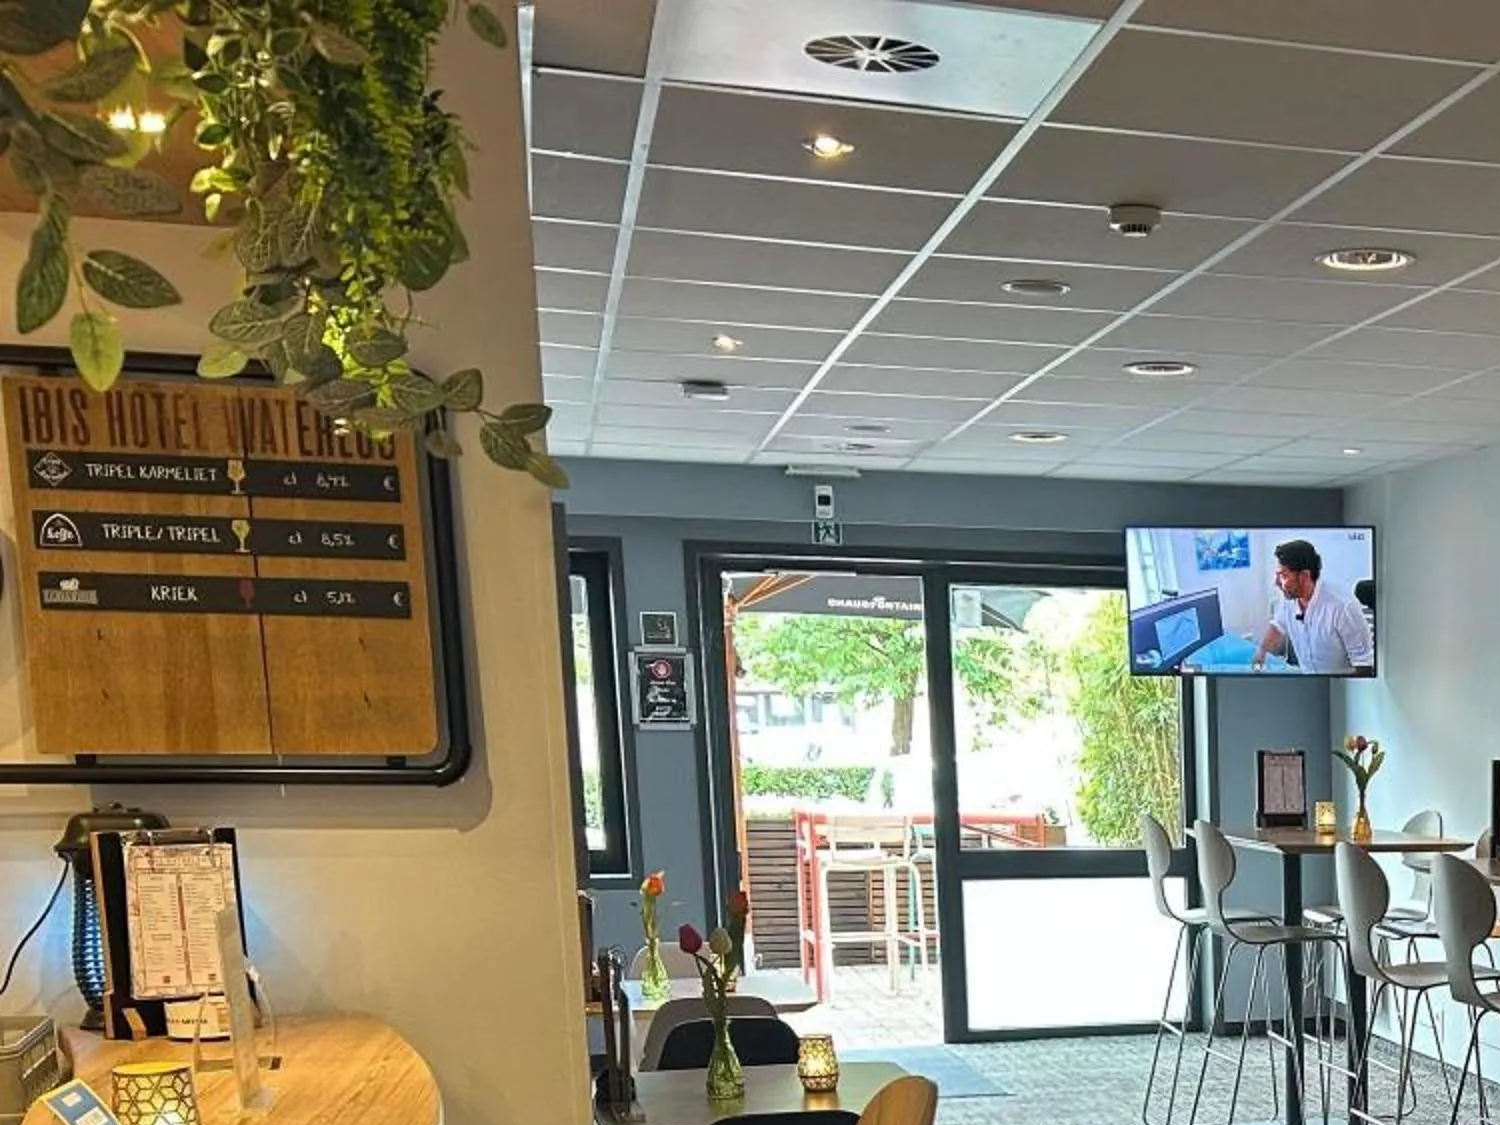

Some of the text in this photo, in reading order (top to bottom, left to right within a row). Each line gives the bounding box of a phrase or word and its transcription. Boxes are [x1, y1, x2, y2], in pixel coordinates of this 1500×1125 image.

[19, 385, 91, 446] IBIS
[105, 389, 208, 451] HOTEL
[85, 463, 136, 479] TRIPEL
[139, 464, 217, 482] KARMELIET
[168, 525, 222, 543] TRIPEL
[151, 584, 199, 601] KRIEK
[827, 596, 923, 612] CHAUDFONTAIN
